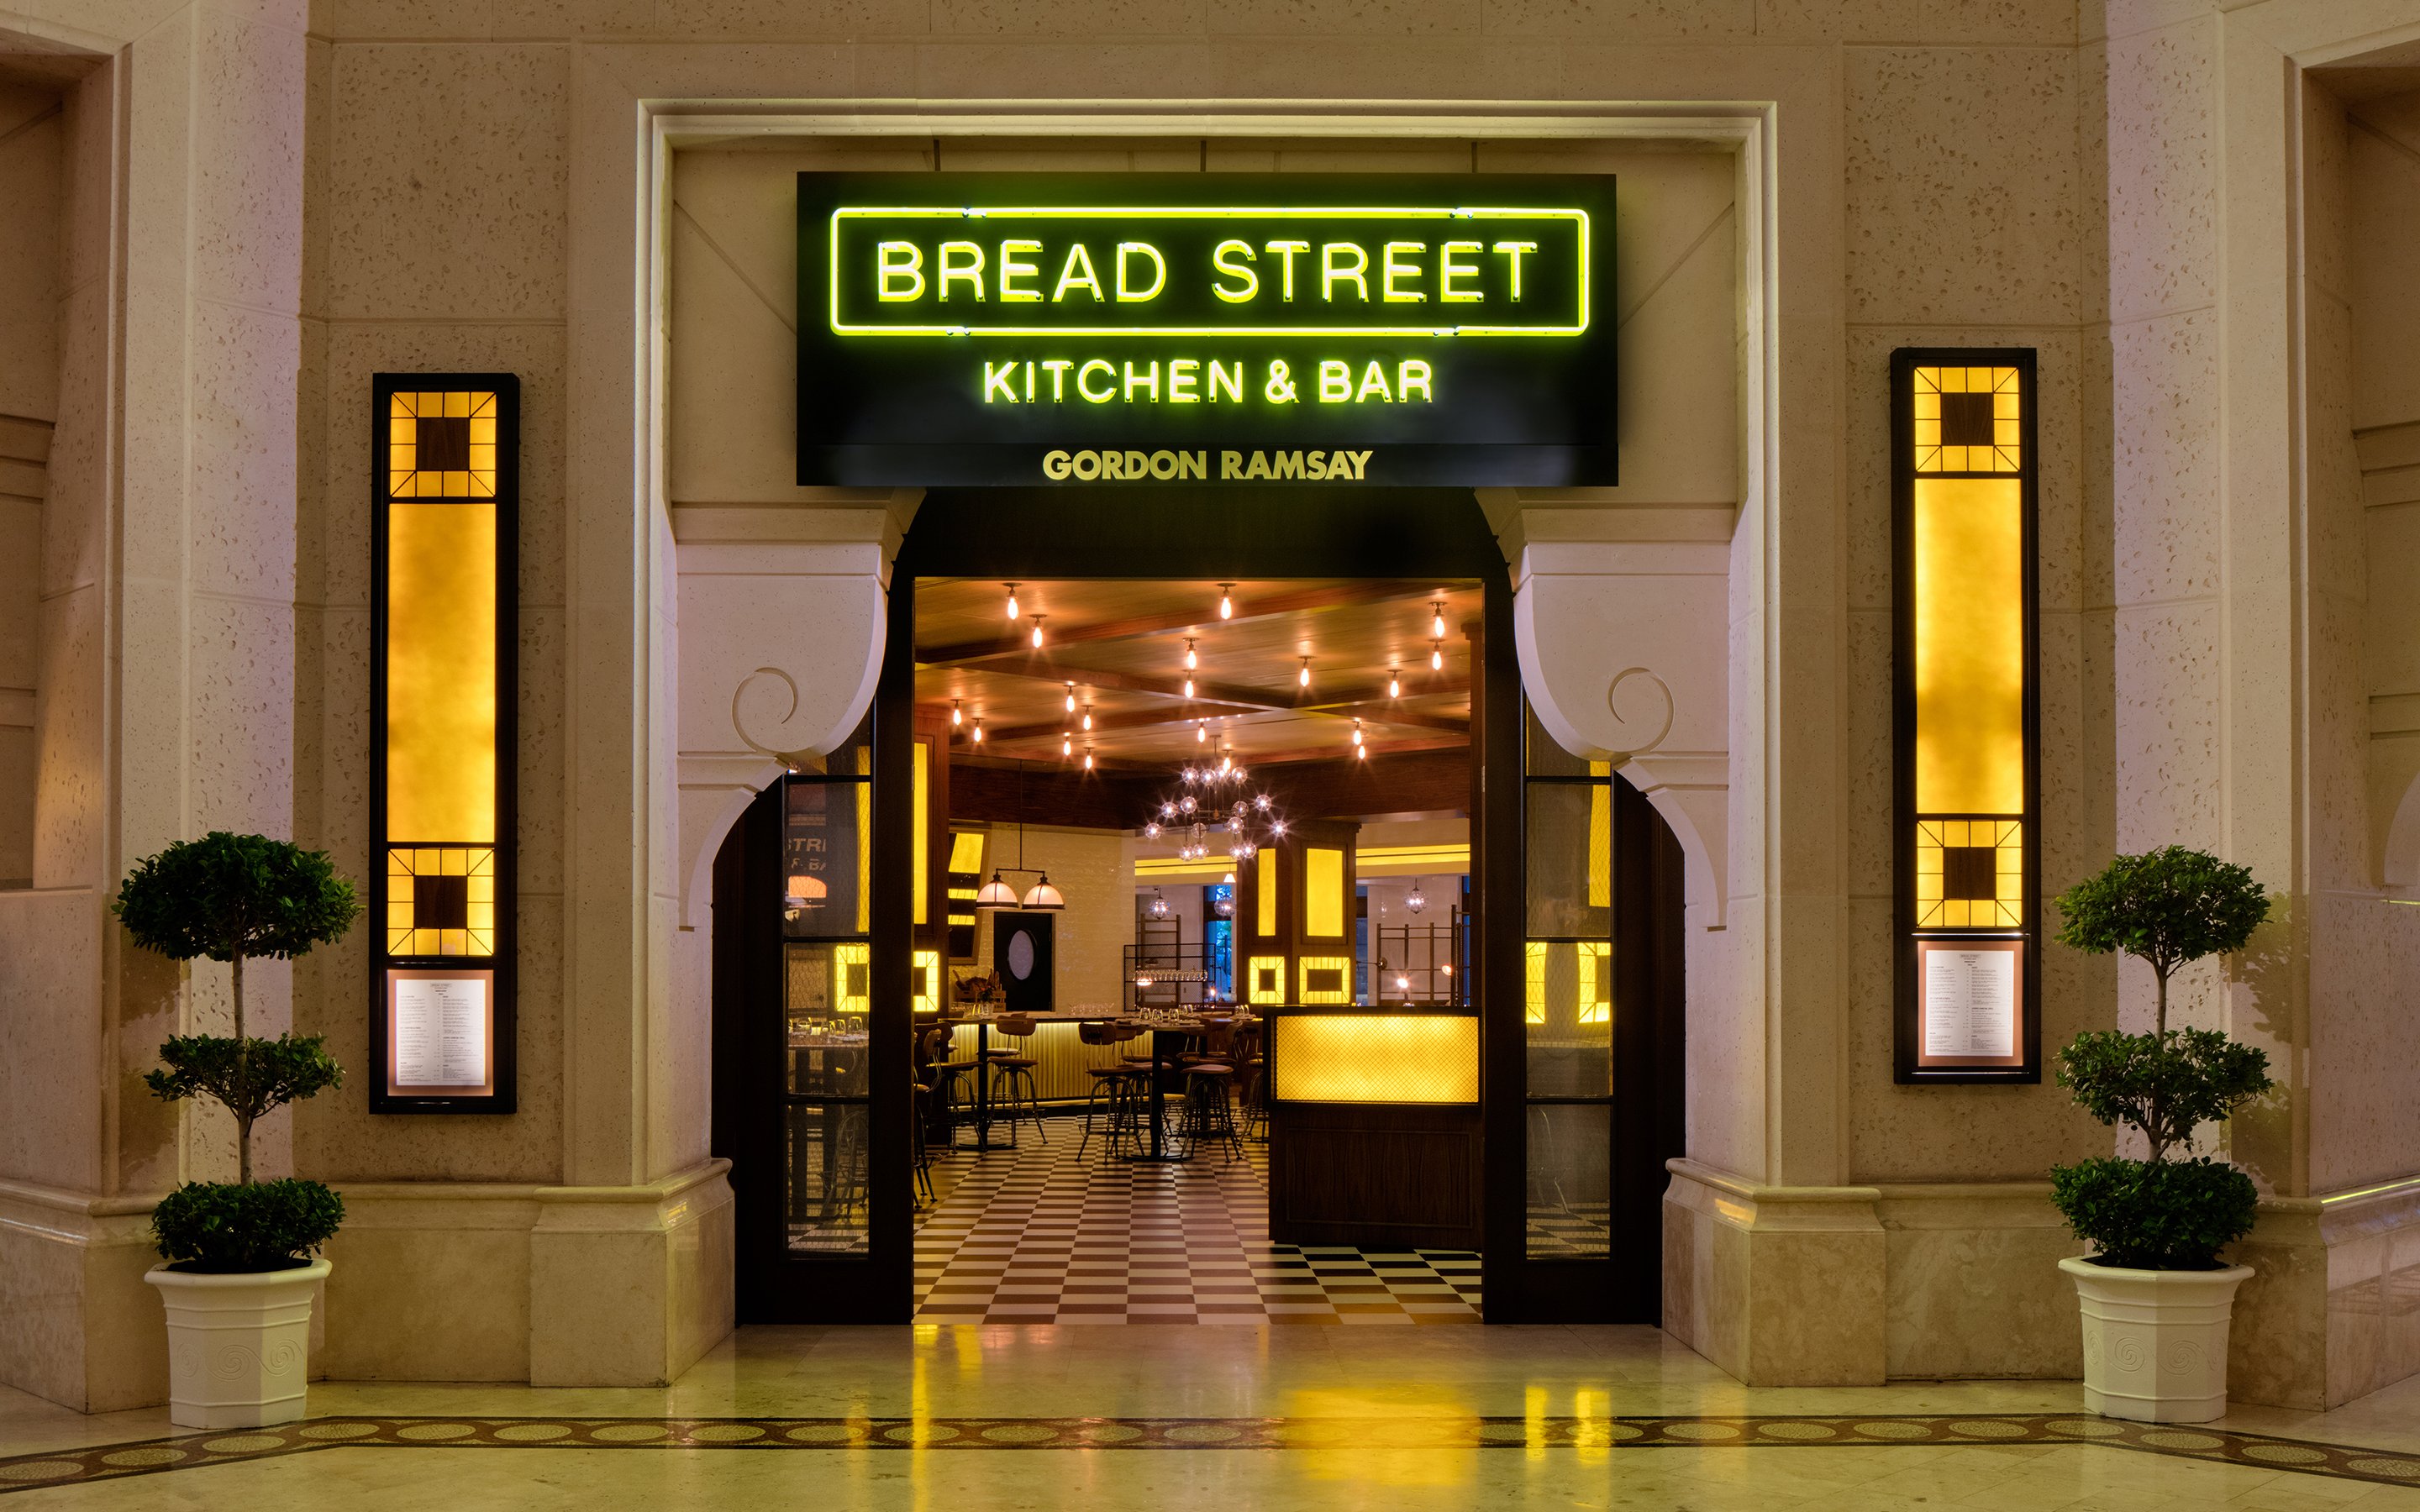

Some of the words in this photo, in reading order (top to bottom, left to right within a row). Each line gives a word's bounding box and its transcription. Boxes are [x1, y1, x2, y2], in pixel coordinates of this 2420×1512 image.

[877, 239, 1167, 303] BREAD
[1211, 239, 1538, 304] STREET
[983, 359, 1244, 405] KITCHEN
[1264, 359, 1300, 405] &
[1318, 359, 1433, 405] BAR
[1042, 449, 1207, 481] GORDON
[1221, 450, 1374, 480] RAMSAY
